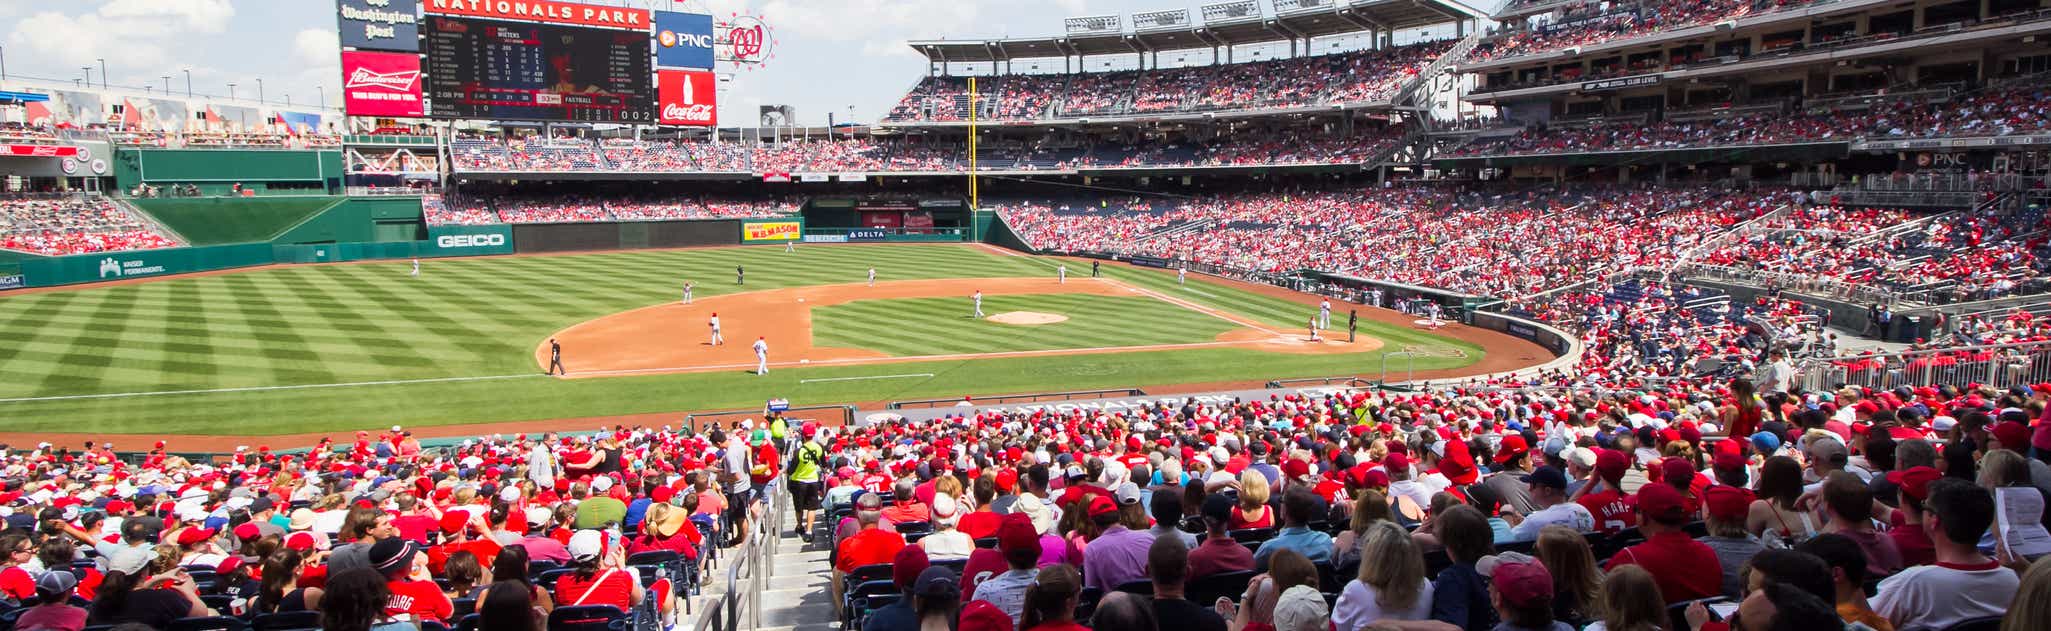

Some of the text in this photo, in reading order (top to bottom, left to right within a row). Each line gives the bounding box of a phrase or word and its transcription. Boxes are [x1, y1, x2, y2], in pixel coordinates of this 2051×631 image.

[342, 4, 415, 25] Washington
[434, 0, 639, 24] NATIONALS PARK
[366, 24, 394, 40] Post
[677, 33, 712, 48] PNC
[351, 72, 412, 84] Budweiser
[663, 103, 713, 120] Coca-Cola
[1934, 153, 1967, 165] PNC
[437, 233, 504, 248] GEICO
